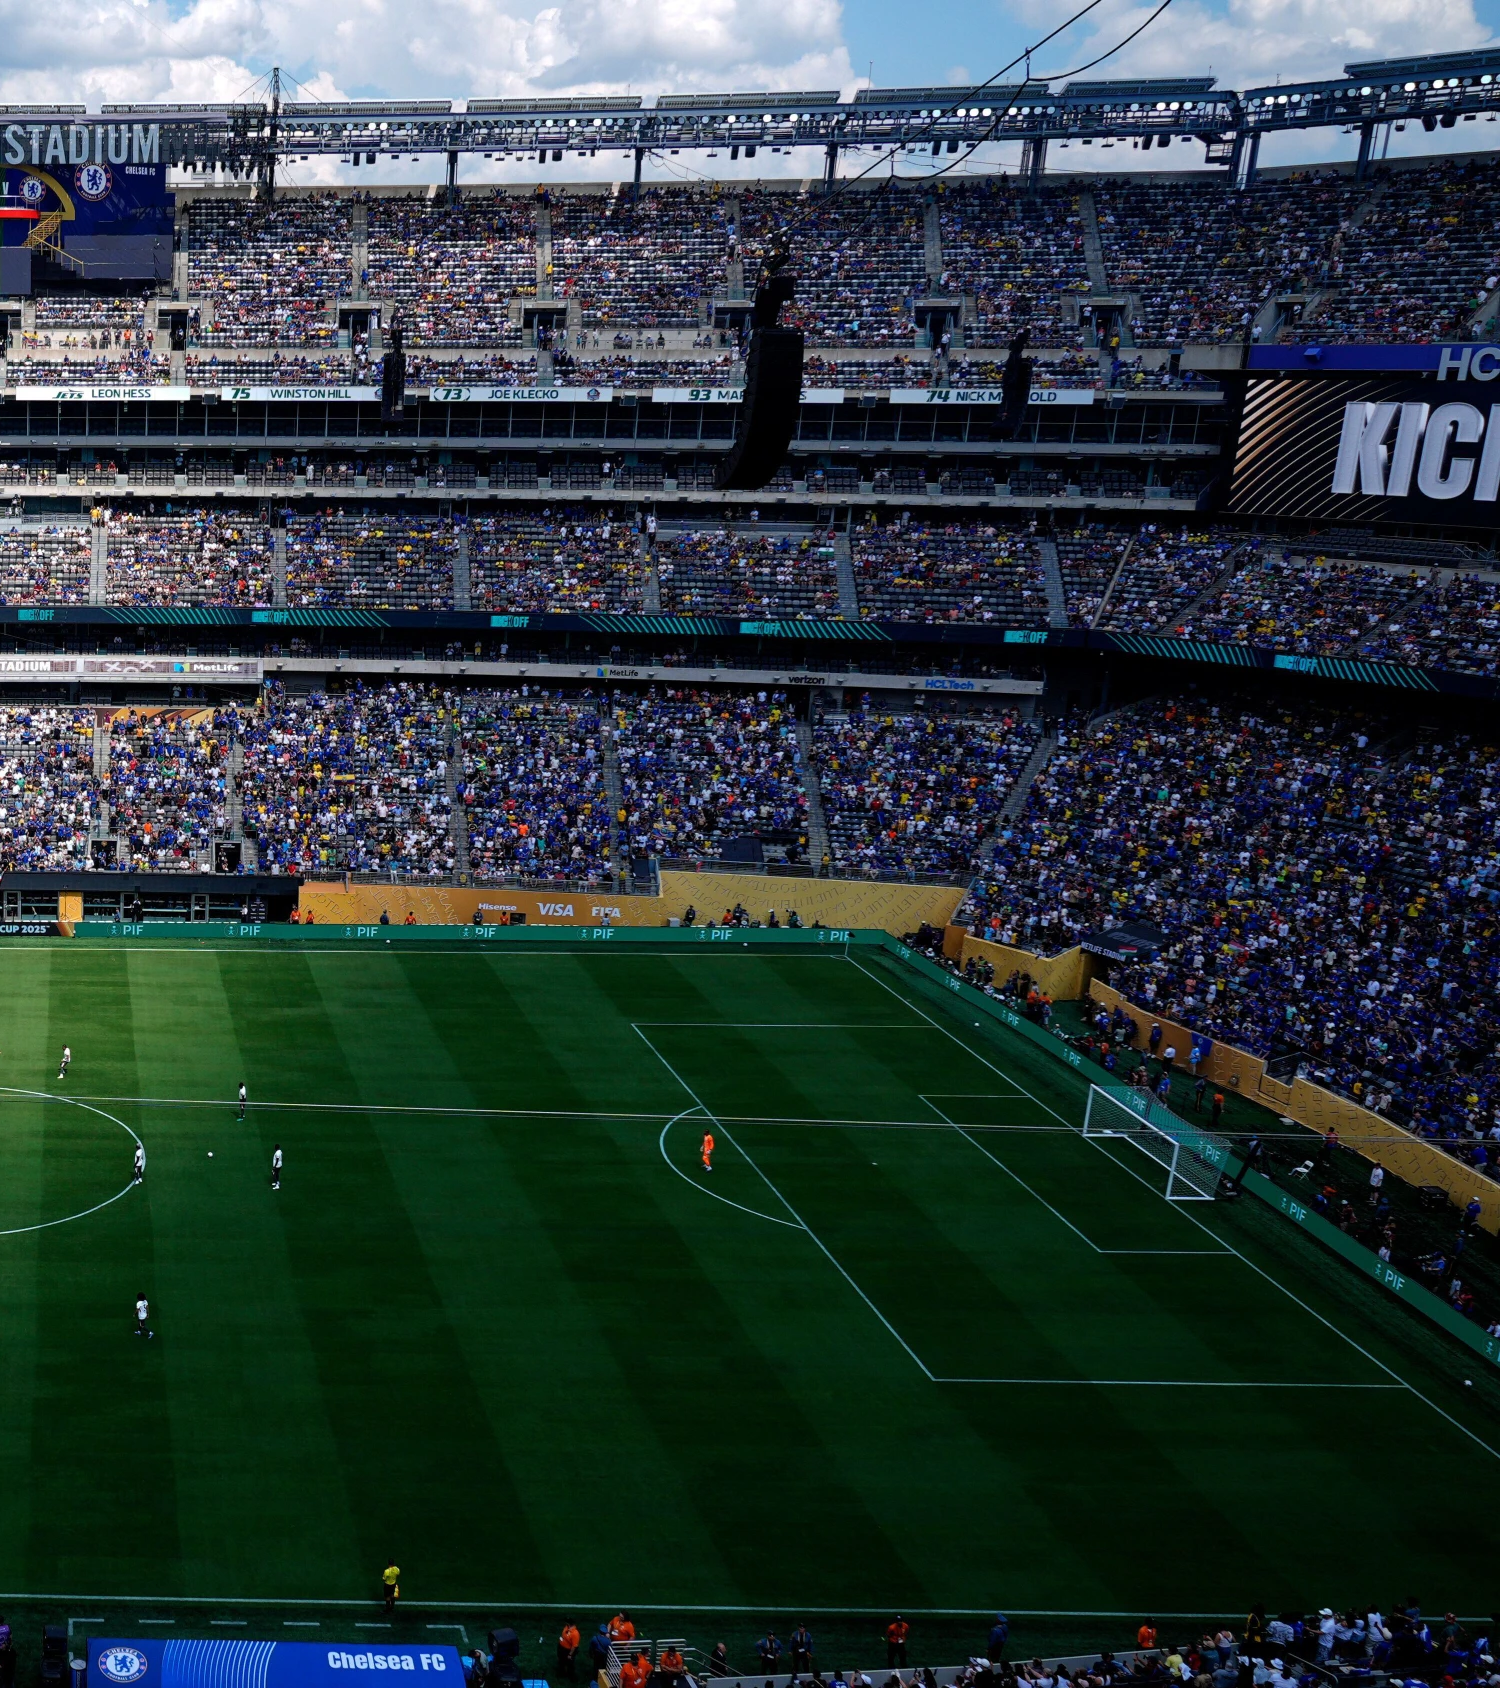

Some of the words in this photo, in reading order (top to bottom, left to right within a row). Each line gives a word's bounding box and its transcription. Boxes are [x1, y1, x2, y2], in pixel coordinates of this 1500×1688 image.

[5, 124, 160, 165] STADIUM
[125, 166, 148, 175] CHELSEA
[2, 181, 10, 195] V
[51, 388, 85, 400] JETS
[91, 388, 122, 399] LEON
[123, 388, 151, 399] HESS
[231, 388, 251, 400] 75
[270, 388, 326, 400] WINSTON
[327, 388, 351, 399] HILL
[441, 388, 463, 400] 73
[488, 389, 511, 400] JOE
[512, 389, 559, 400] KLECKO
[688, 389, 712, 401] 93
[925, 390, 950, 402] 74
[955, 391, 986, 402] NICK
[987, 391, 1057, 403] MOLD
[1331, 401, 1500, 501] KIC
[39, 609, 54, 620] OFF
[274, 611, 289, 622] OFF
[513, 616, 529, 628] OFF
[764, 622, 780, 635] OFF
[1029, 631, 1048, 644] OFF
[193, 663, 240, 672] MetLife
[1299, 657, 1318, 672] OFF
[609, 669, 639, 677] MetLife
[788, 675, 825, 684] verizon
[925, 679, 975, 690] HCLTech
[478, 902, 517, 911] Hisense
[536, 902, 575, 917] VISA
[591, 907, 621, 918] FIFA
[0, 924, 19, 933] CUP
[123, 925, 143, 935] PIF
[240, 926, 261, 936] PIF
[357, 926, 378, 937] PIF
[475, 927, 496, 938] PIF
[593, 929, 614, 939] PIF
[711, 930, 733, 940] PIF
[900, 947, 911, 959] PIF
[1081, 941, 1103, 956] METLIFE
[950, 978, 961, 991] PIF
[1007, 1012, 1019, 1026] PIF
[1069, 1052, 1081, 1067] PIF
[1132, 1095, 1147, 1111] PIF
[1206, 1145, 1220, 1162] PIF
[1289, 1202, 1307, 1221] PIF
[1384, 1269, 1405, 1291] PIF
[106, 1647, 138, 1657] CHELSEA
[327, 1651, 415, 1671] Chelsea
[420, 1653, 447, 1671] FC
